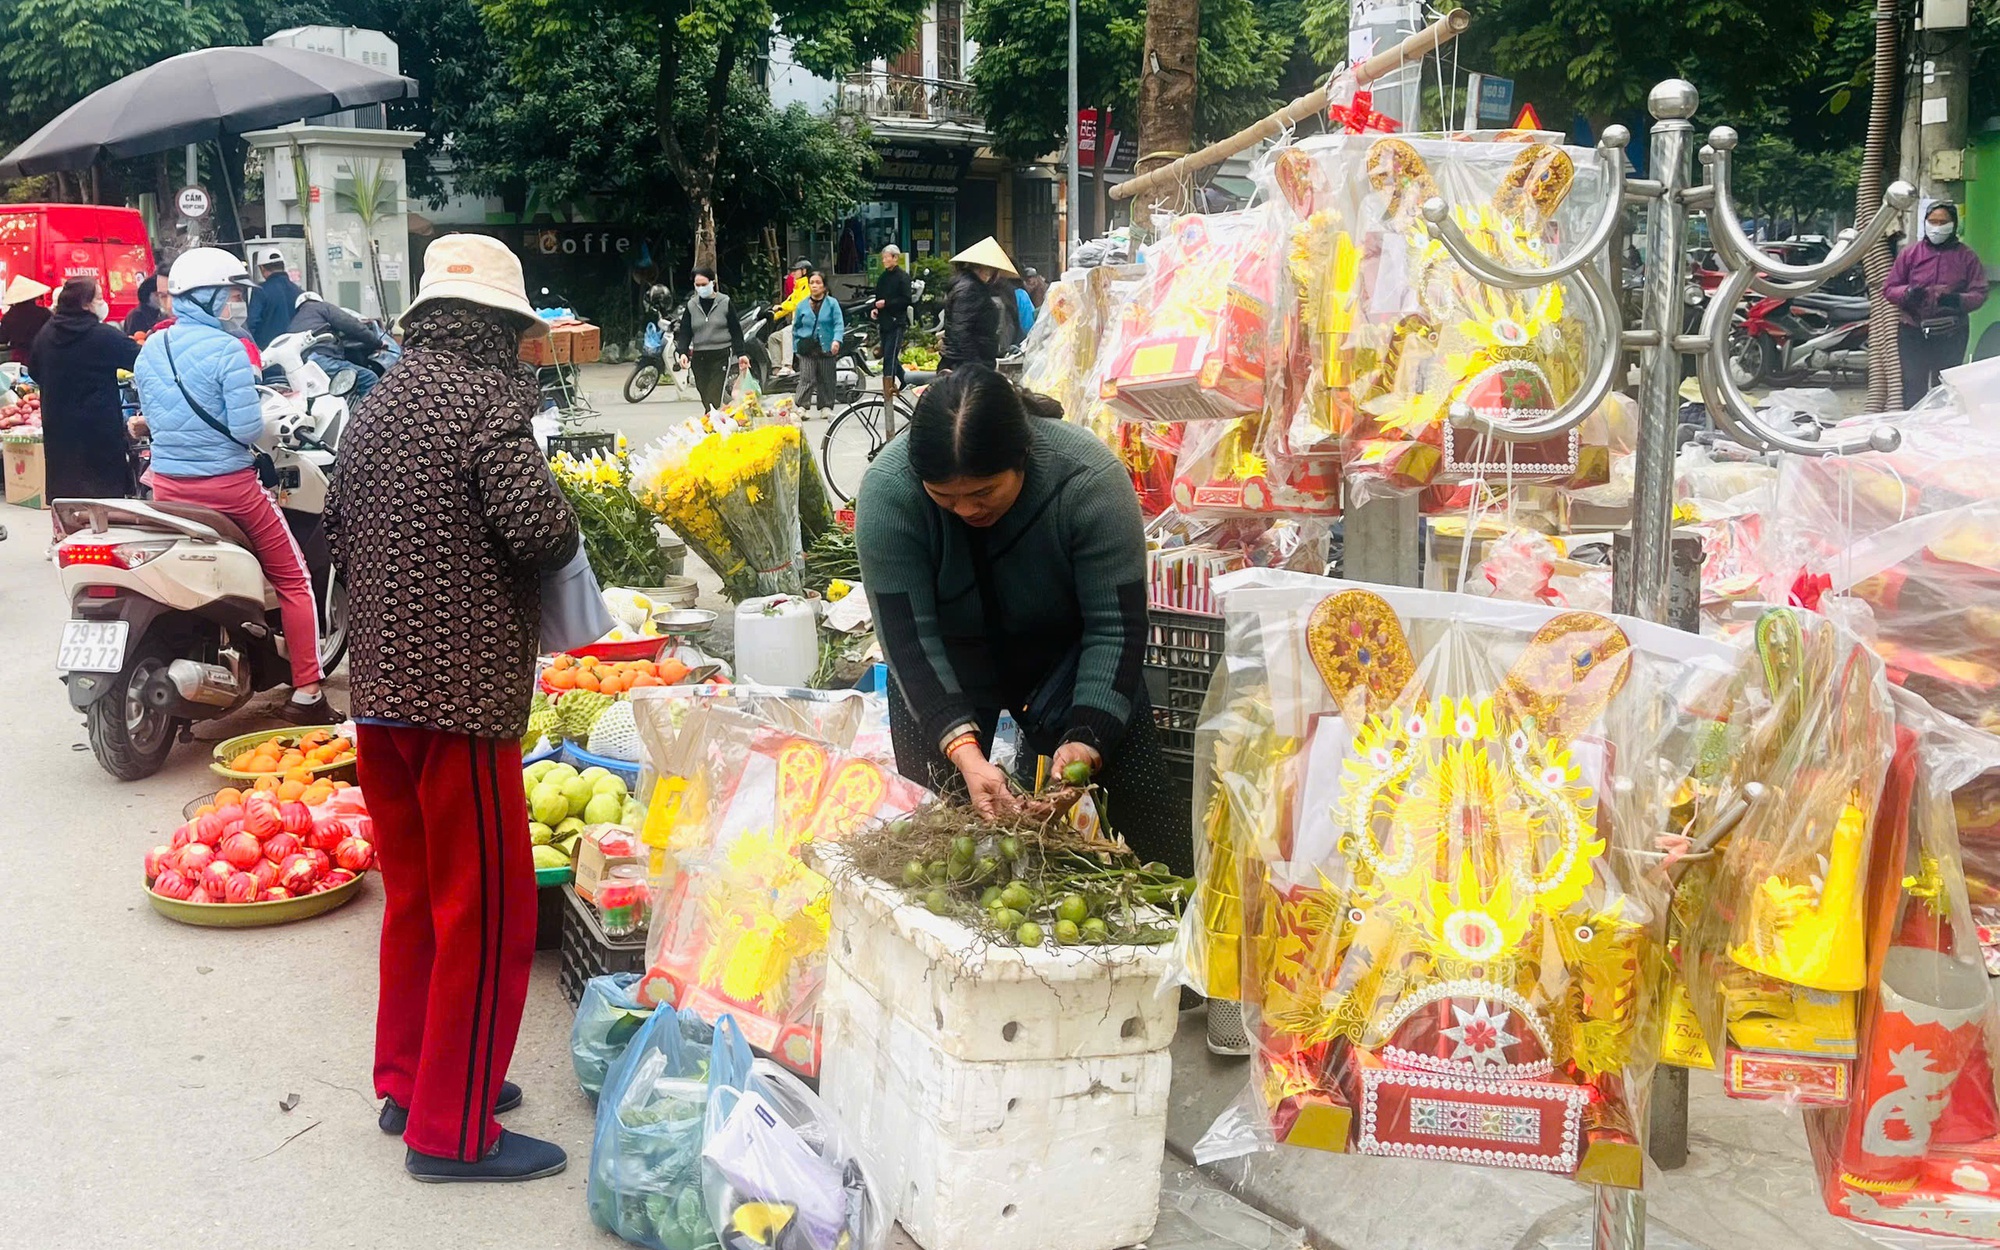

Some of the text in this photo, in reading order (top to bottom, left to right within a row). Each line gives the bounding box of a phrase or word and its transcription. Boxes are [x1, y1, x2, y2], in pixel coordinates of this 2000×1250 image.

[539, 233, 630, 254] Coffe
[64, 267, 100, 277] MAJESTIC
[69, 624, 118, 645] 29-X3
[60, 646, 120, 668] 273.72
[1673, 1044, 1703, 1058] An
